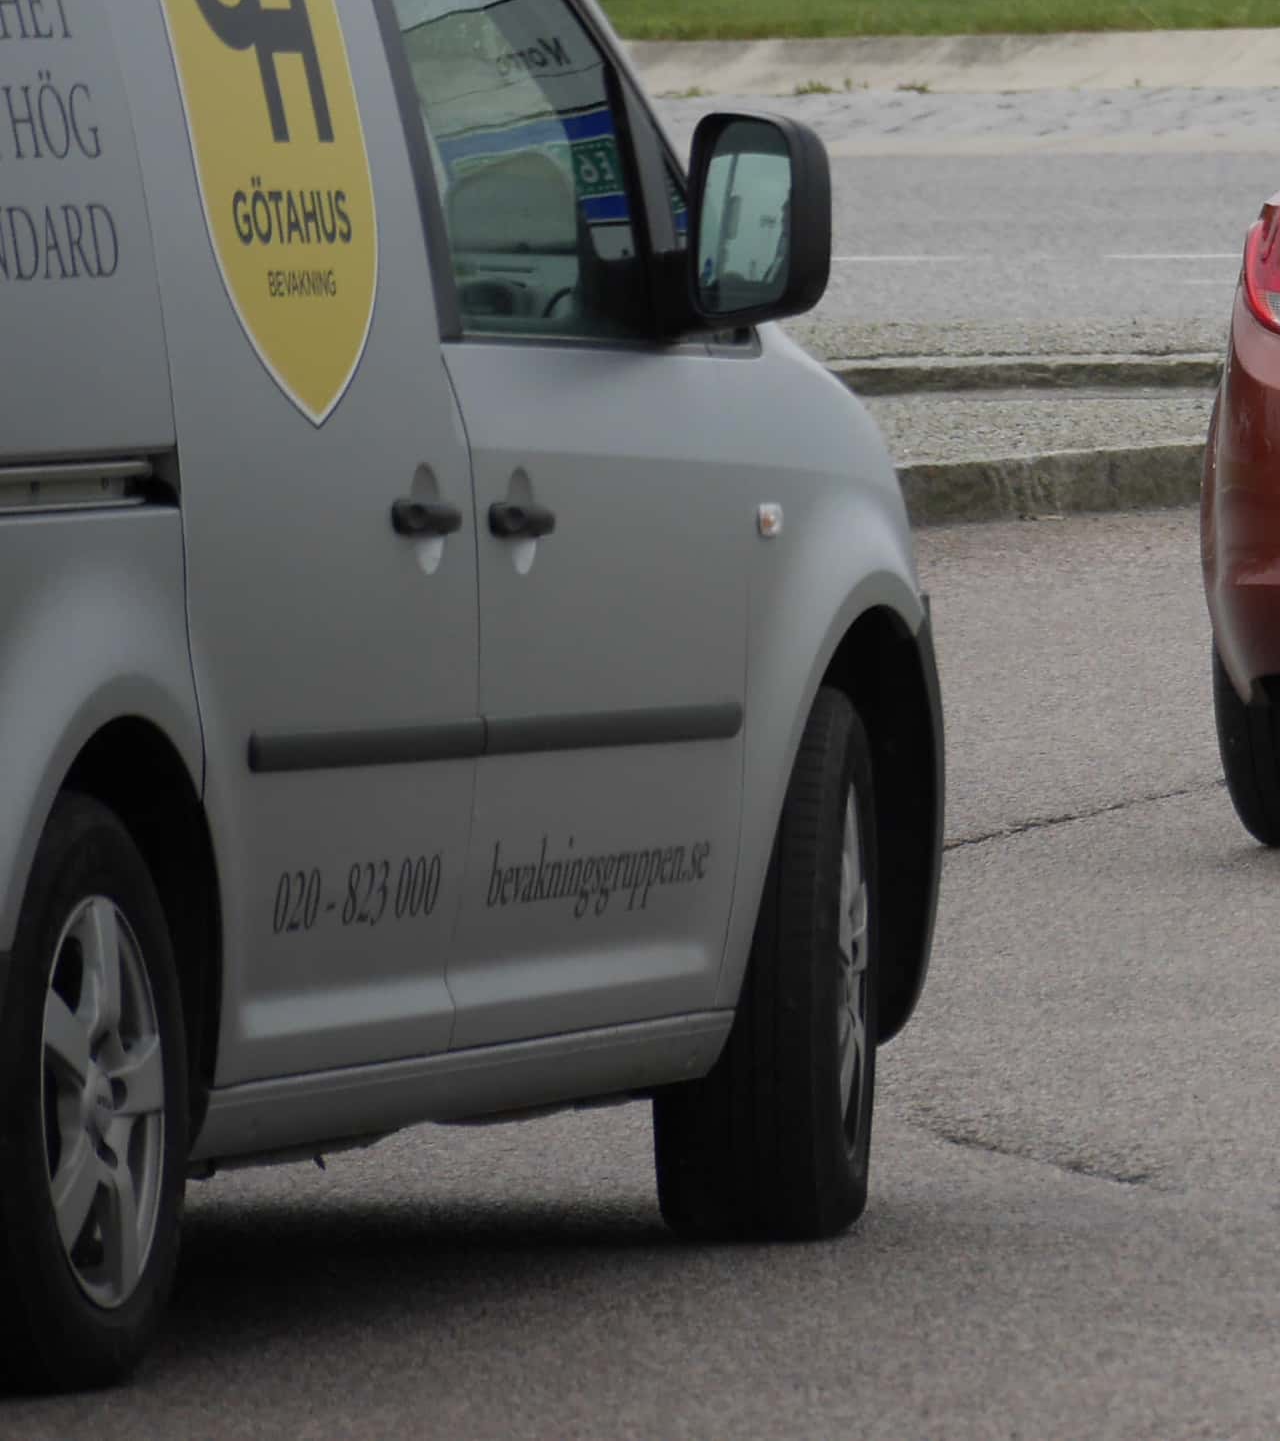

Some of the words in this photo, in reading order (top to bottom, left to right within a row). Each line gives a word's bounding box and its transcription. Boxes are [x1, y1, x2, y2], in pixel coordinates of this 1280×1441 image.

[1, 69, 101, 159] HÖG
[232, 176, 352, 246] GÖTAHUS
[267, 268, 337, 298] BEVAKNING
[273, 867, 321, 934] 020
[342, 859, 390, 927] 823
[395, 852, 442, 919] 000
[486, 833, 711, 919] bevakningsgruppen.se
